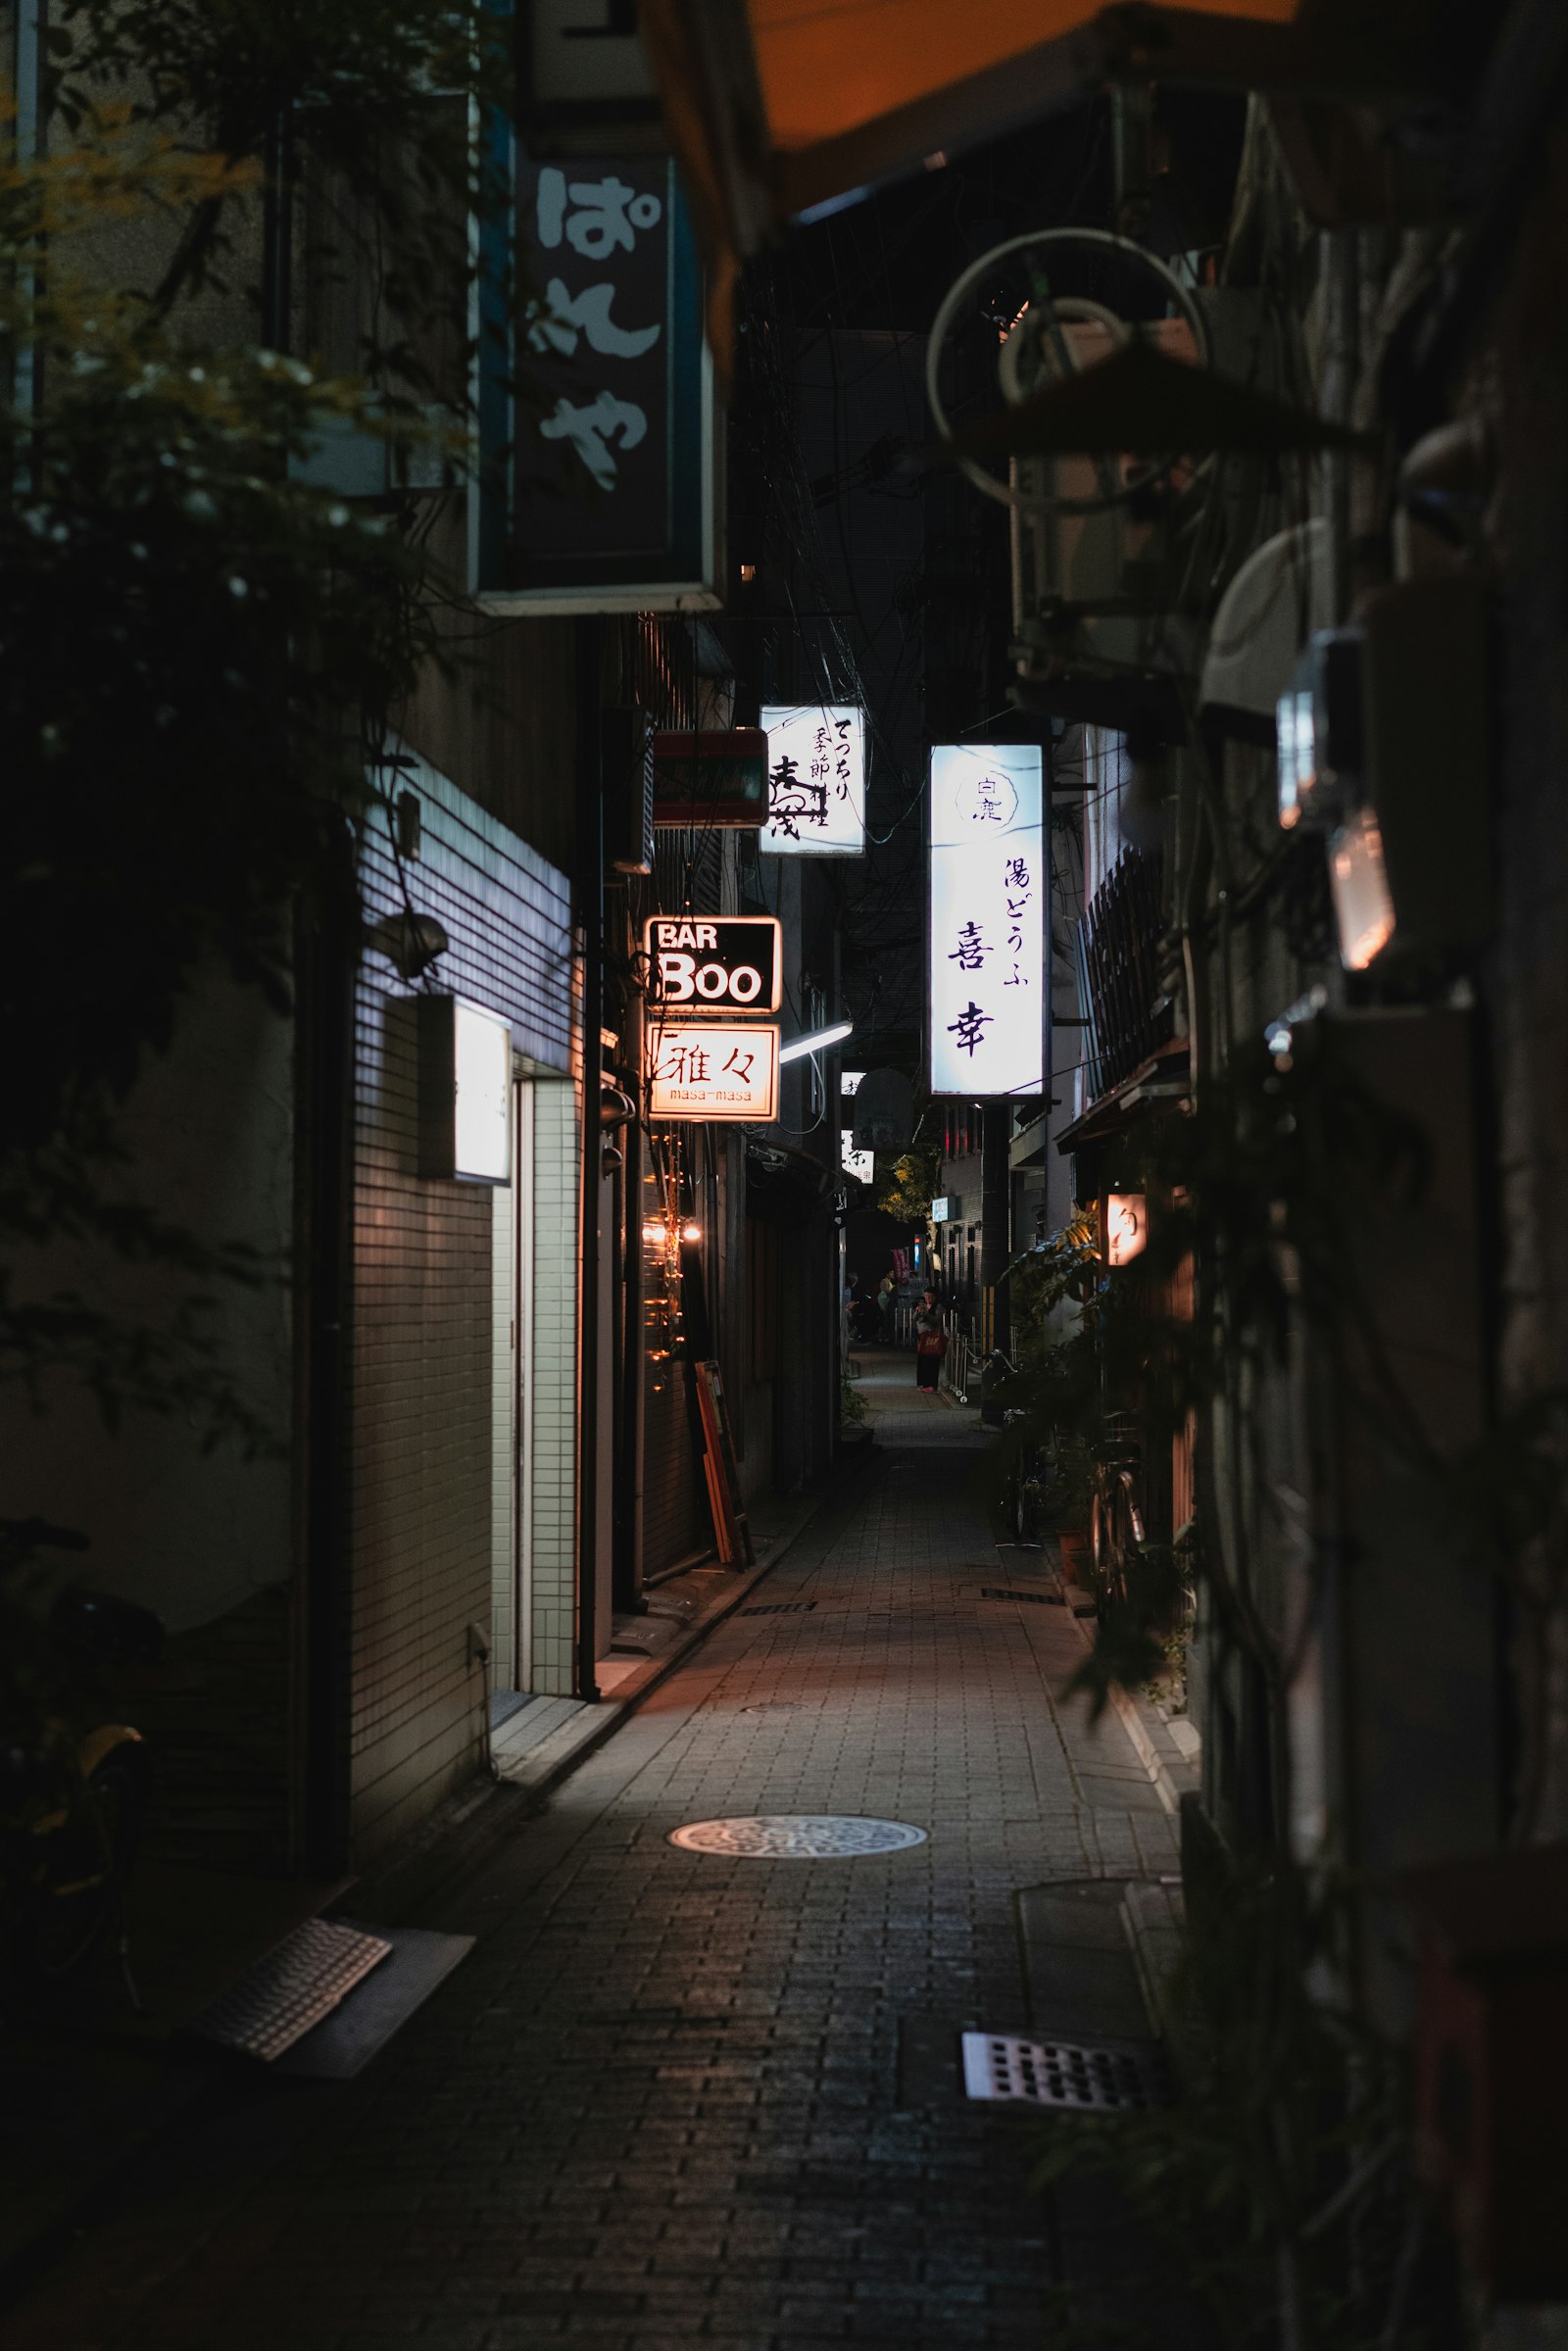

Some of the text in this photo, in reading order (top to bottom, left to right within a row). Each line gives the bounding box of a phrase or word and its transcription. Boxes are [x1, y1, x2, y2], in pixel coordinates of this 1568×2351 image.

[658, 924, 717, 949] BAR
[1004, 857, 1032, 987] 湯どうふ
[948, 921, 995, 1058] 喜幸
[669, 1045, 755, 1085] 雅々
[670, 1089, 752, 1102] masa-masa
